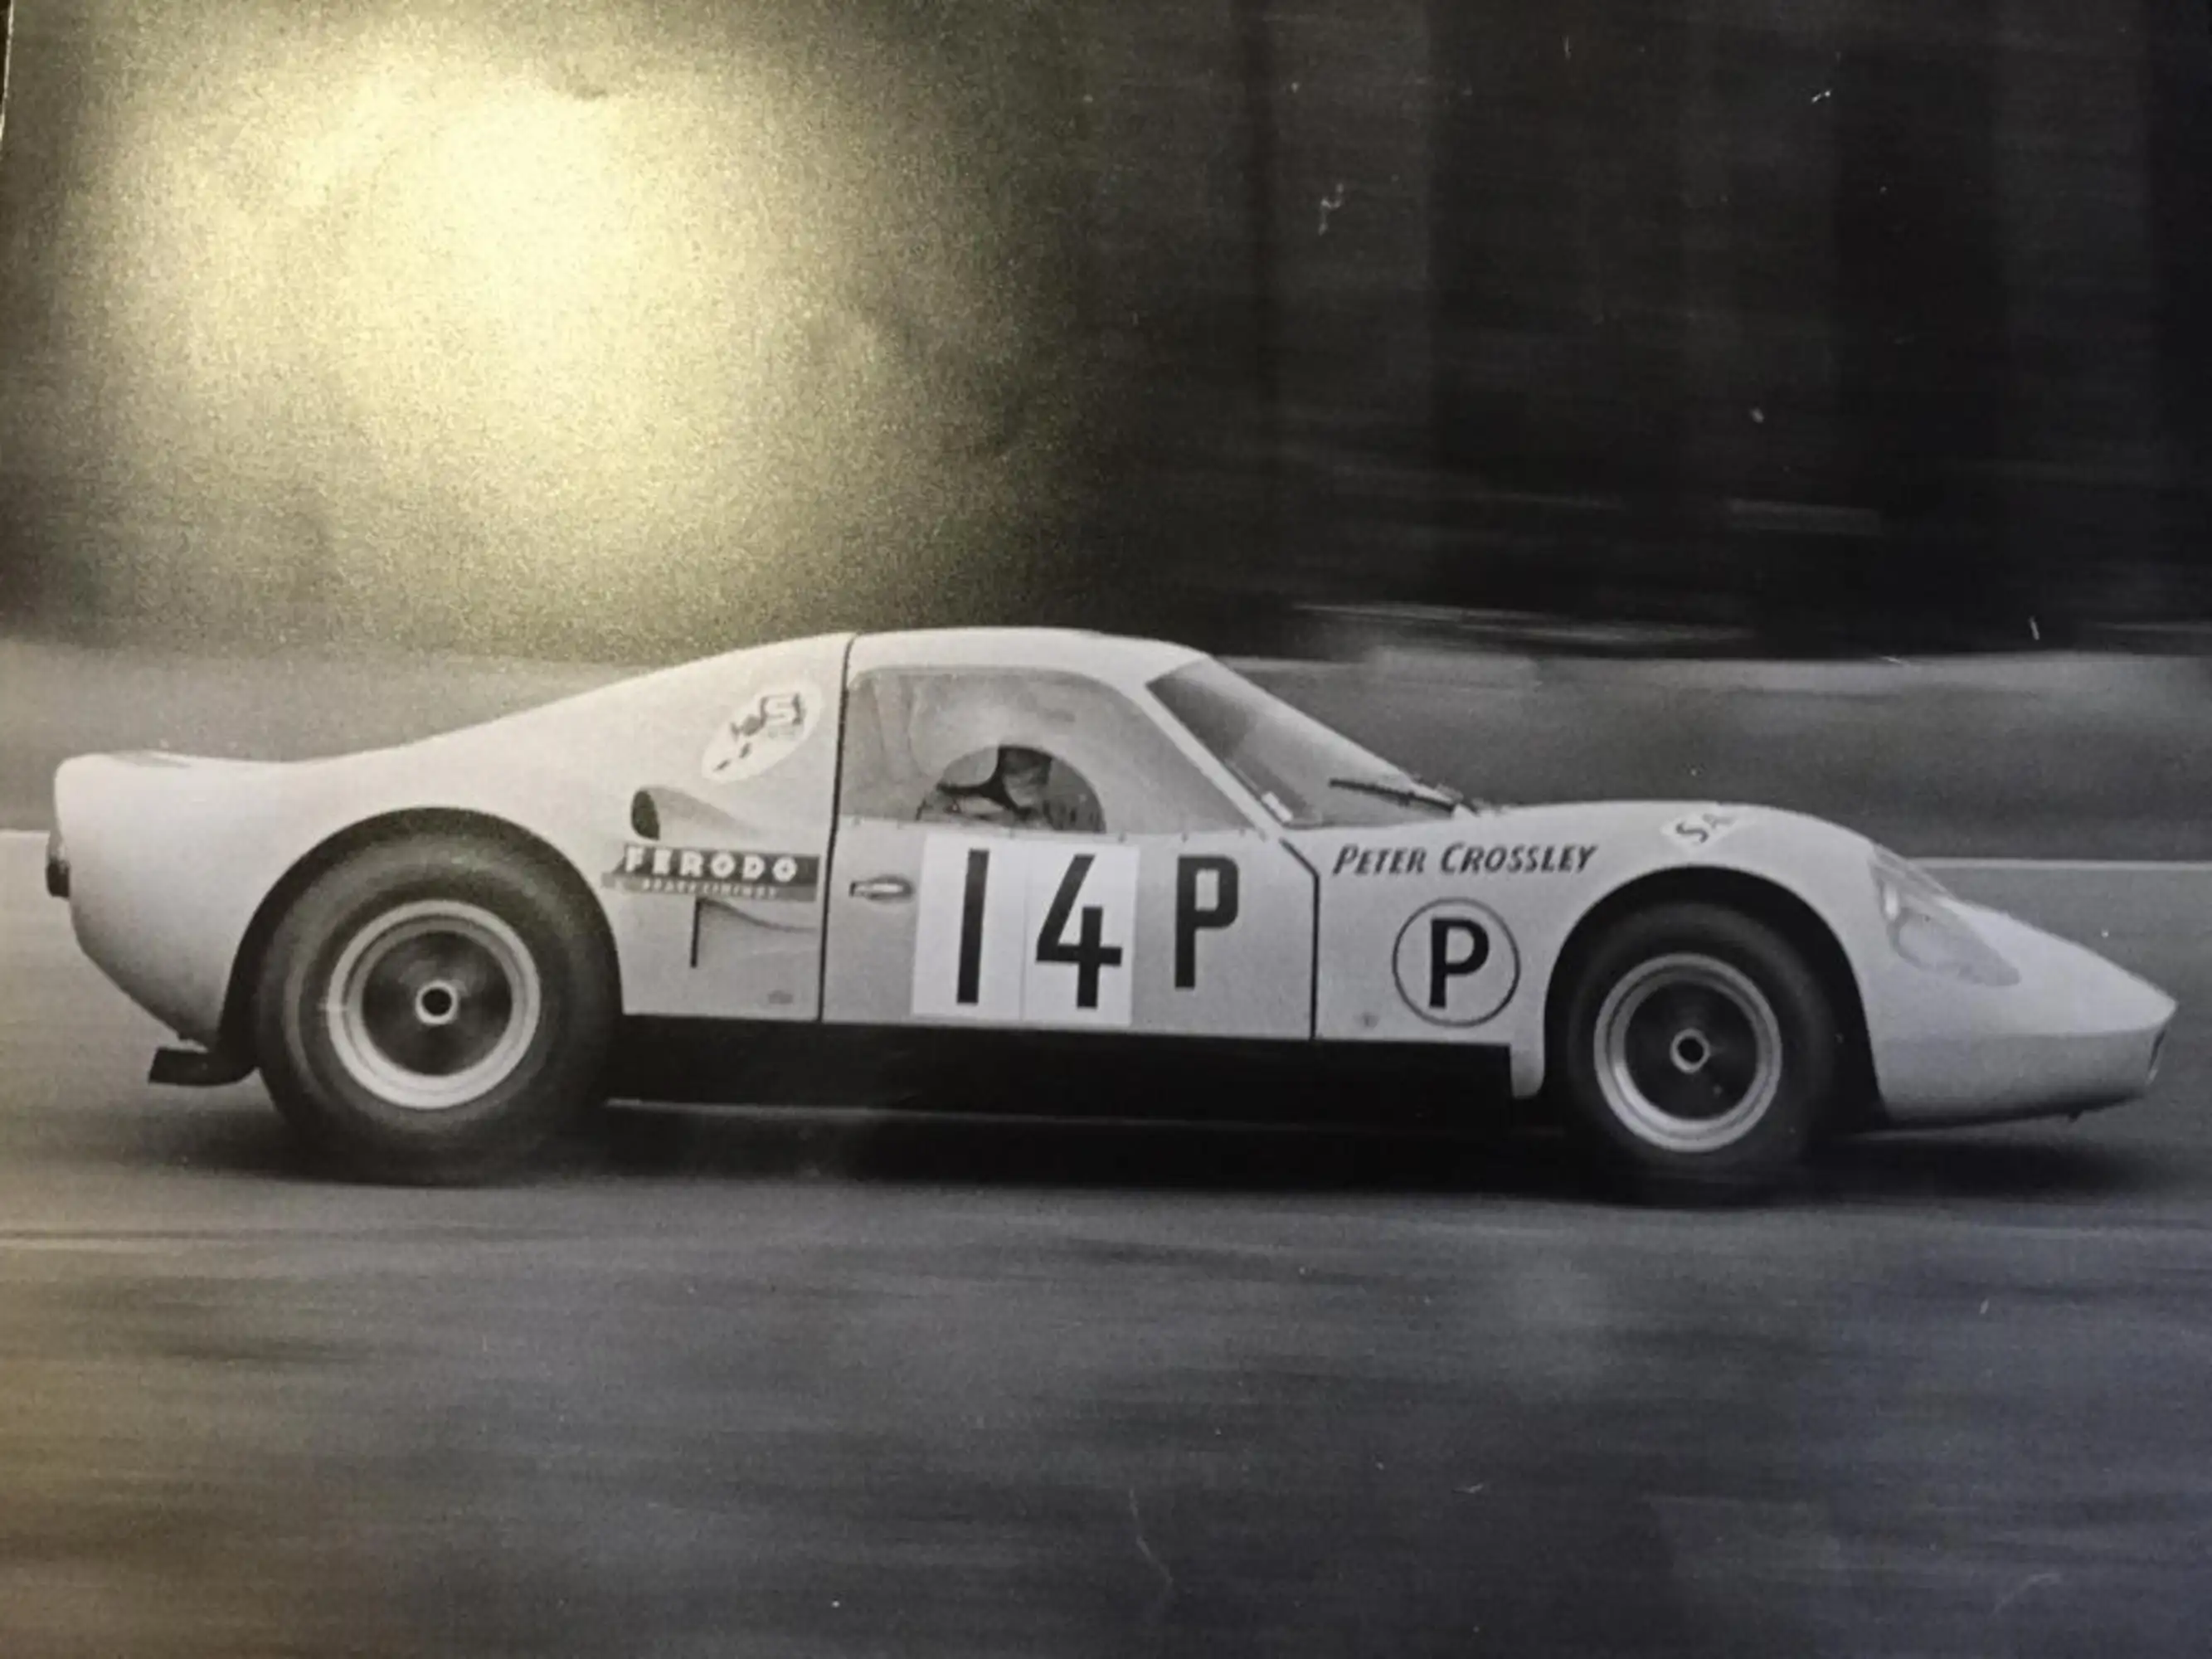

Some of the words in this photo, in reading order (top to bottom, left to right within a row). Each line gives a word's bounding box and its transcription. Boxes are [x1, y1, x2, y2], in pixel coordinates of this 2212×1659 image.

[625, 846, 798, 883] FERODO
[1332, 844, 1427, 876] PETER
[1440, 842, 1598, 873] CROSSLEY
[956, 849, 1123, 1010] 14
[1174, 854, 1239, 990] P
[1429, 917, 1490, 1010] P
